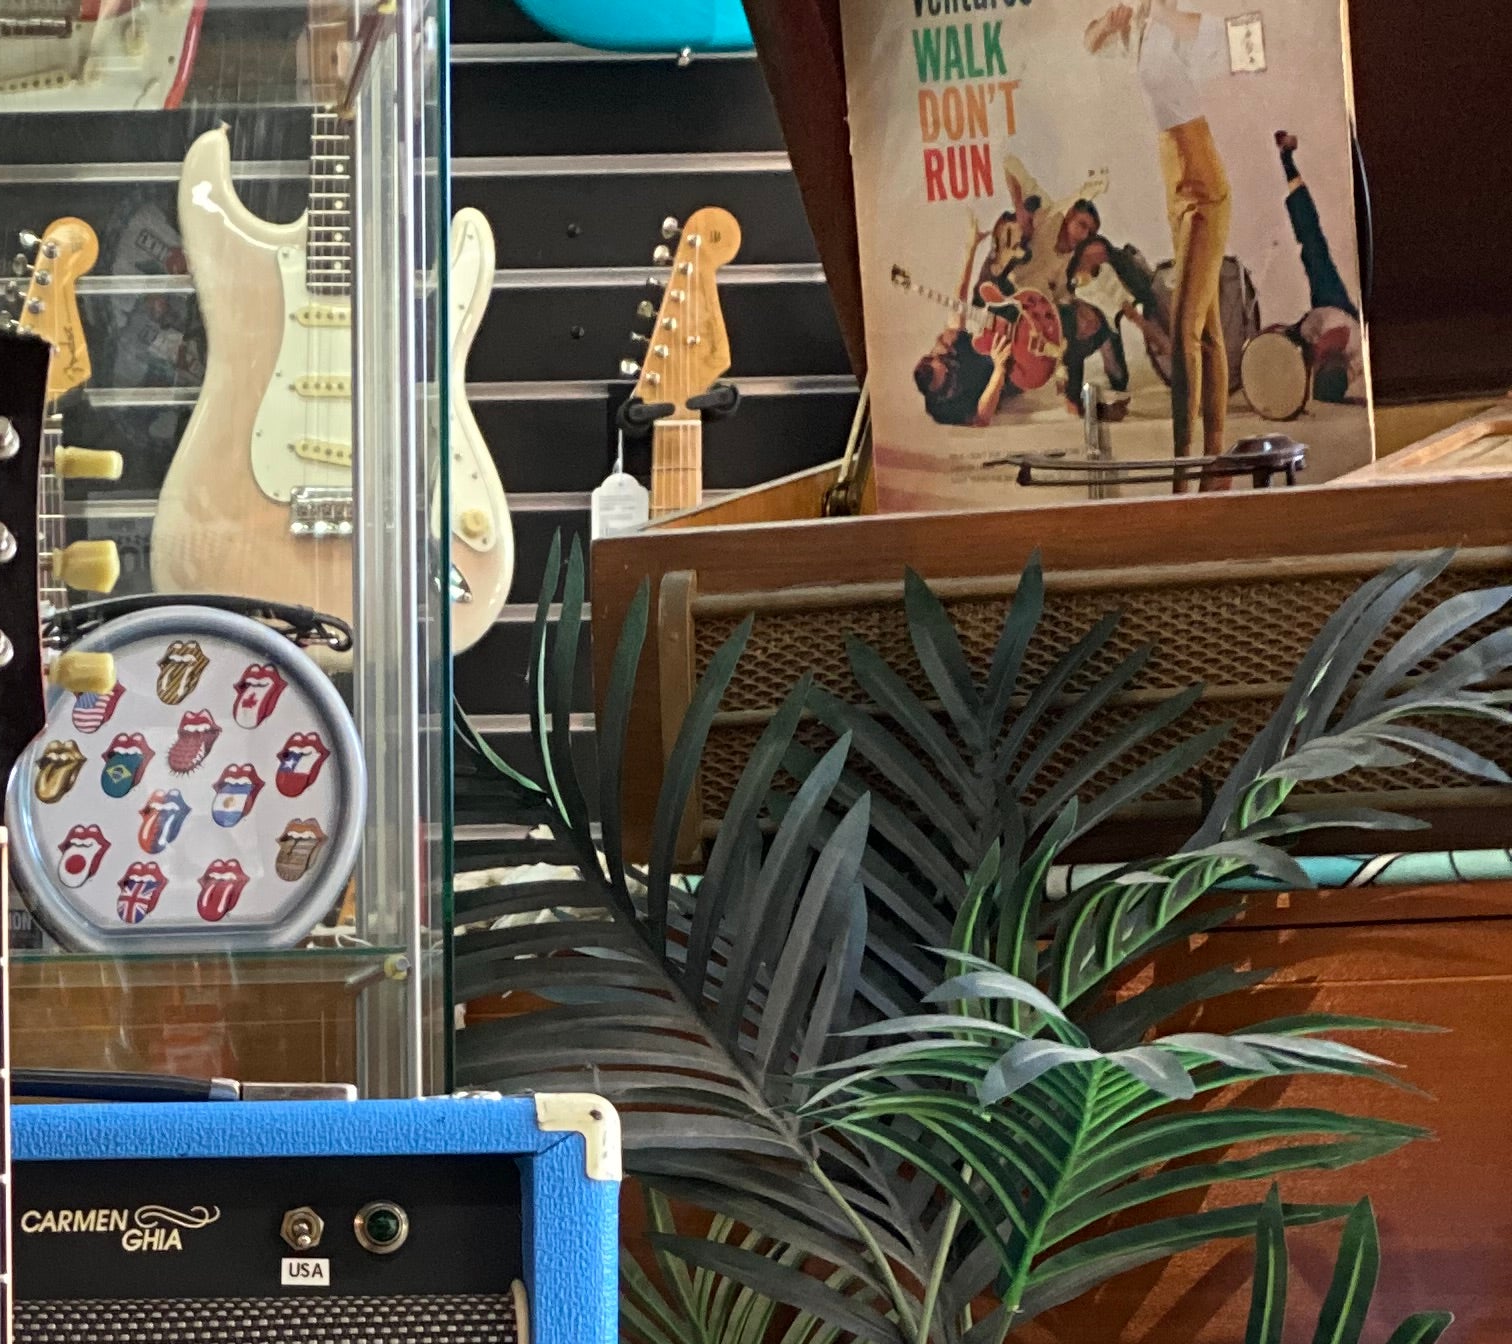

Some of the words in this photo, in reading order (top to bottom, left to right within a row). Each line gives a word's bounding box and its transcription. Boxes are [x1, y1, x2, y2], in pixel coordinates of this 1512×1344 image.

[912, 19, 1008, 83] WALK
[918, 79, 1022, 143] DON'T
[923, 143, 994, 202] RUN
[20, 1208, 129, 1233] CARMEN
[121, 1228, 183, 1251] GHIA
[288, 1262, 324, 1279] USA
